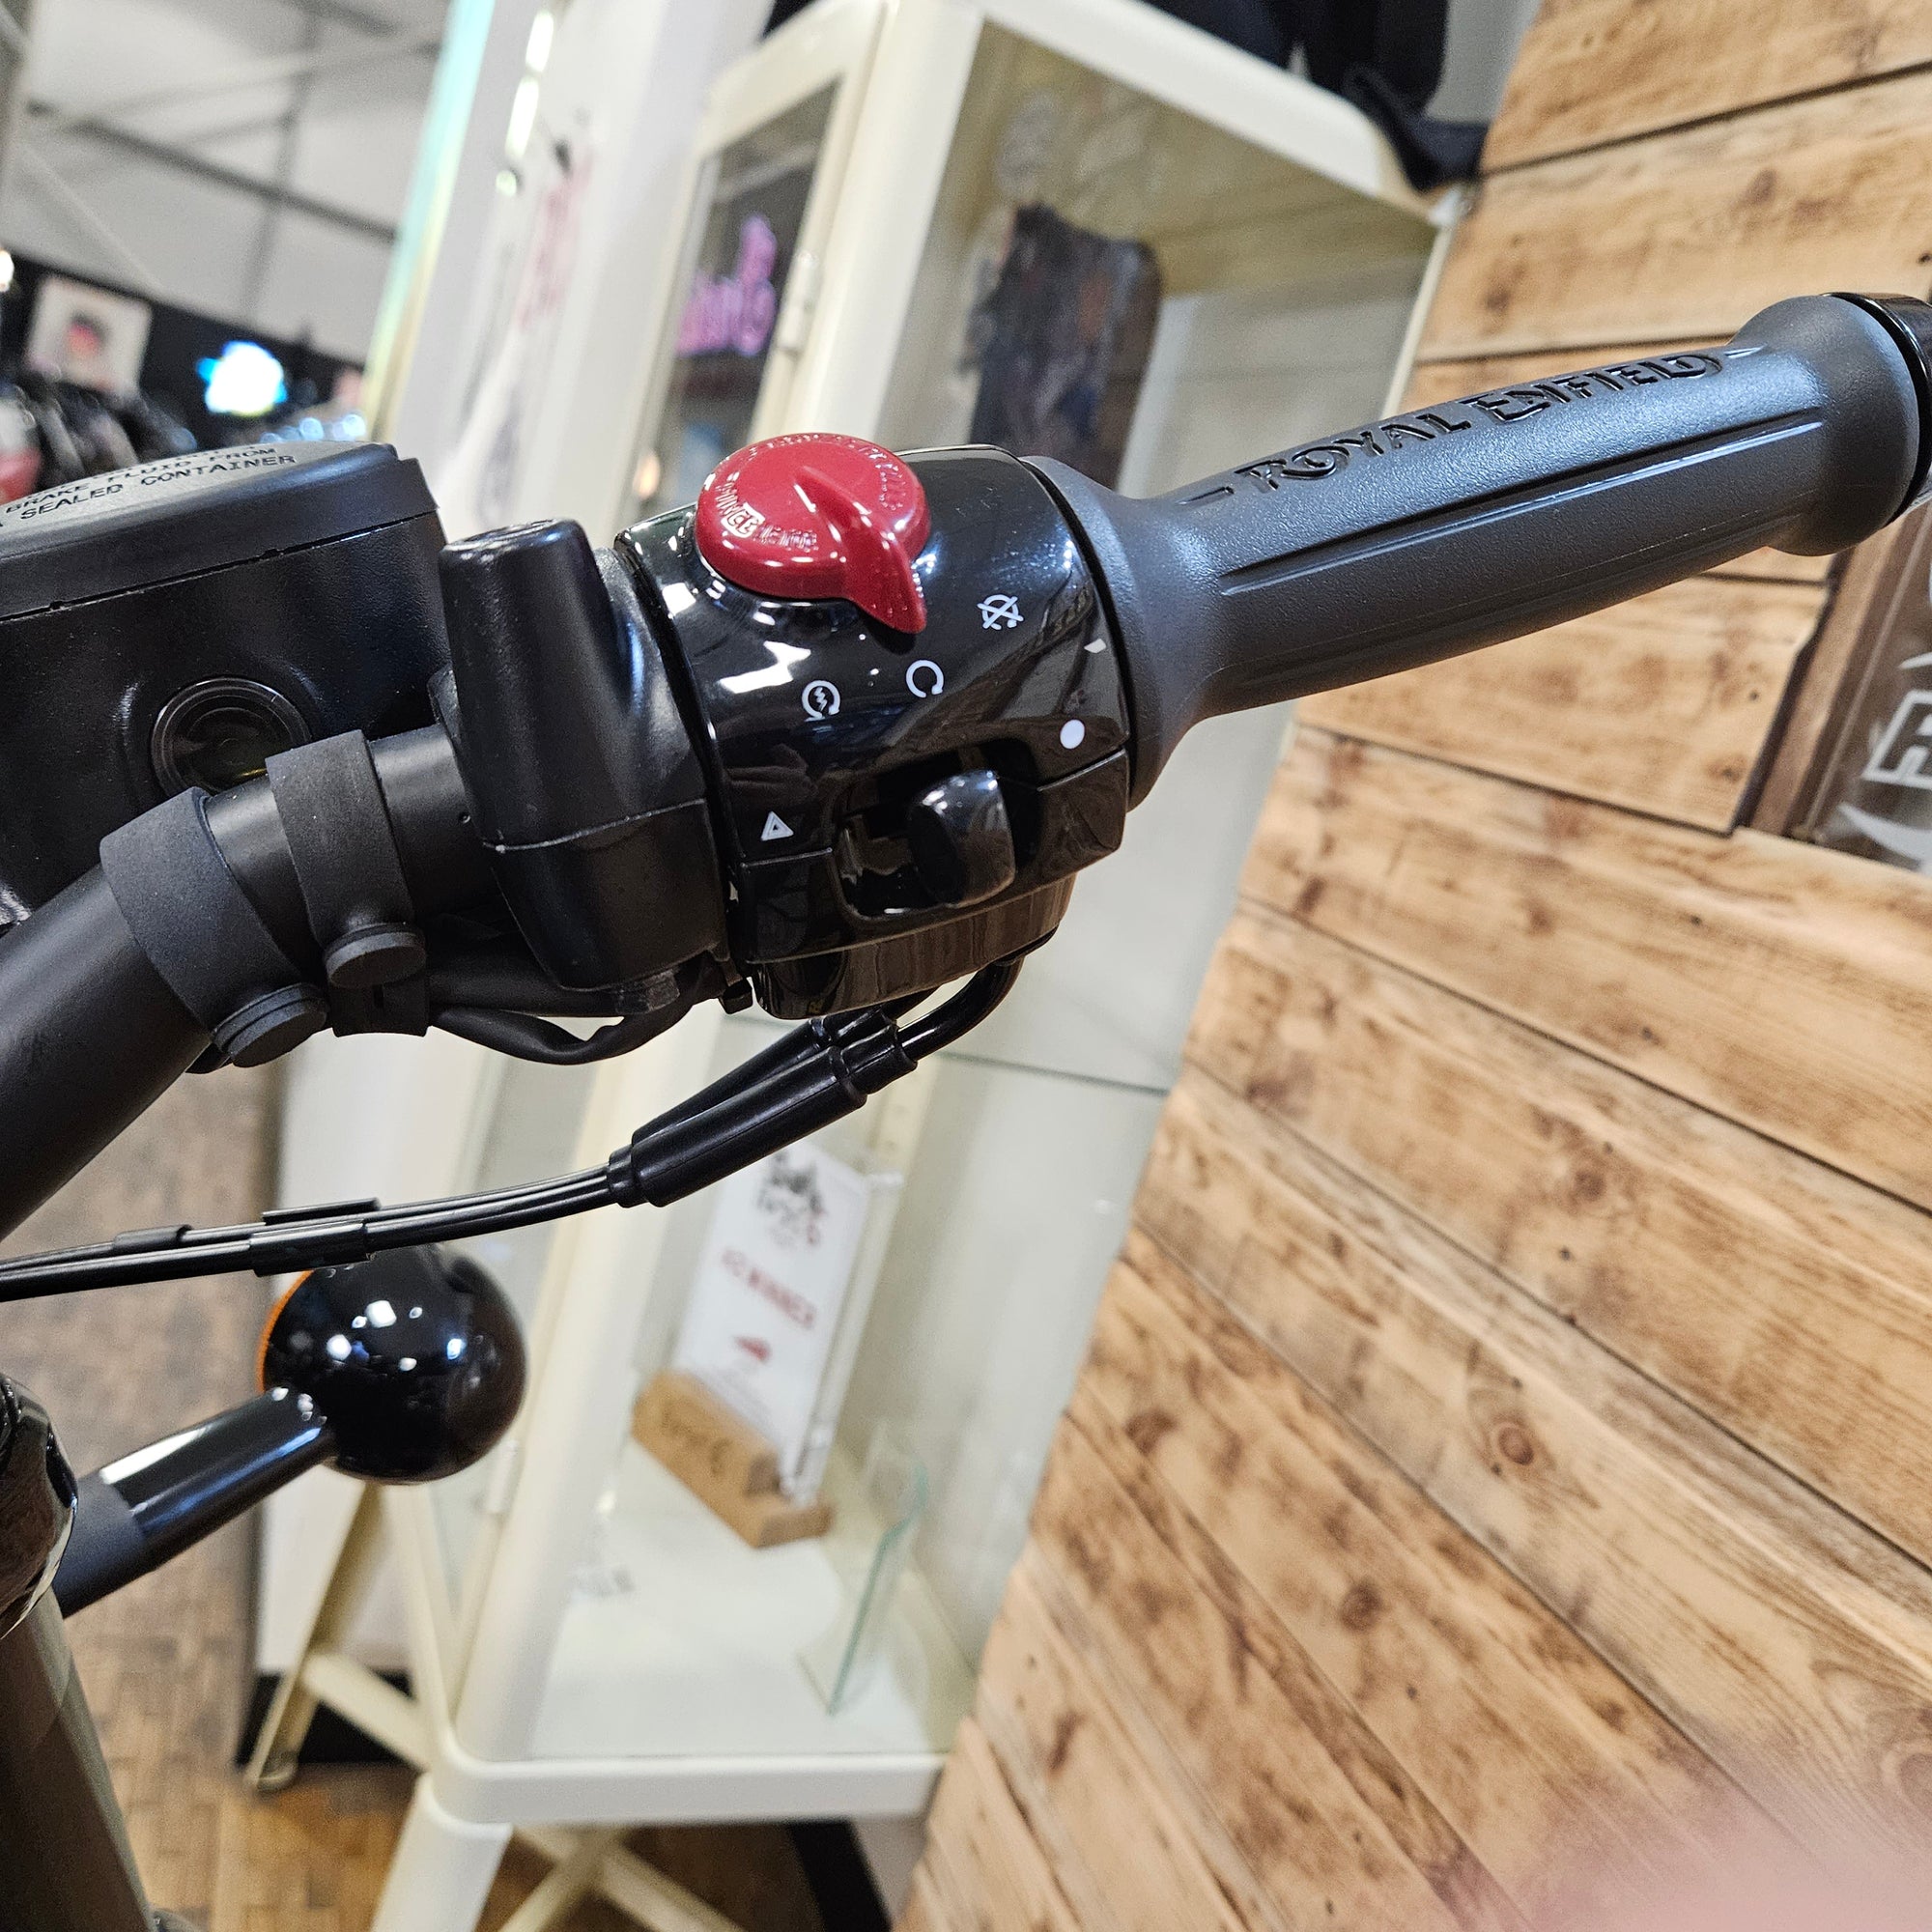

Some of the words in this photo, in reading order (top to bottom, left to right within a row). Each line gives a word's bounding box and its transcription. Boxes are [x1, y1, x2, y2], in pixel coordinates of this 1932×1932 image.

[1234, 412, 1472, 493] ROYAL
[1458, 354, 1723, 423] ENFIELD
[5, 483, 90, 514] BRAKE
[107, 460, 192, 482] FLUID
[209, 447, 277, 462] FROM
[19, 483, 124, 520] SEALED
[140, 455, 297, 486] CONTAINER
